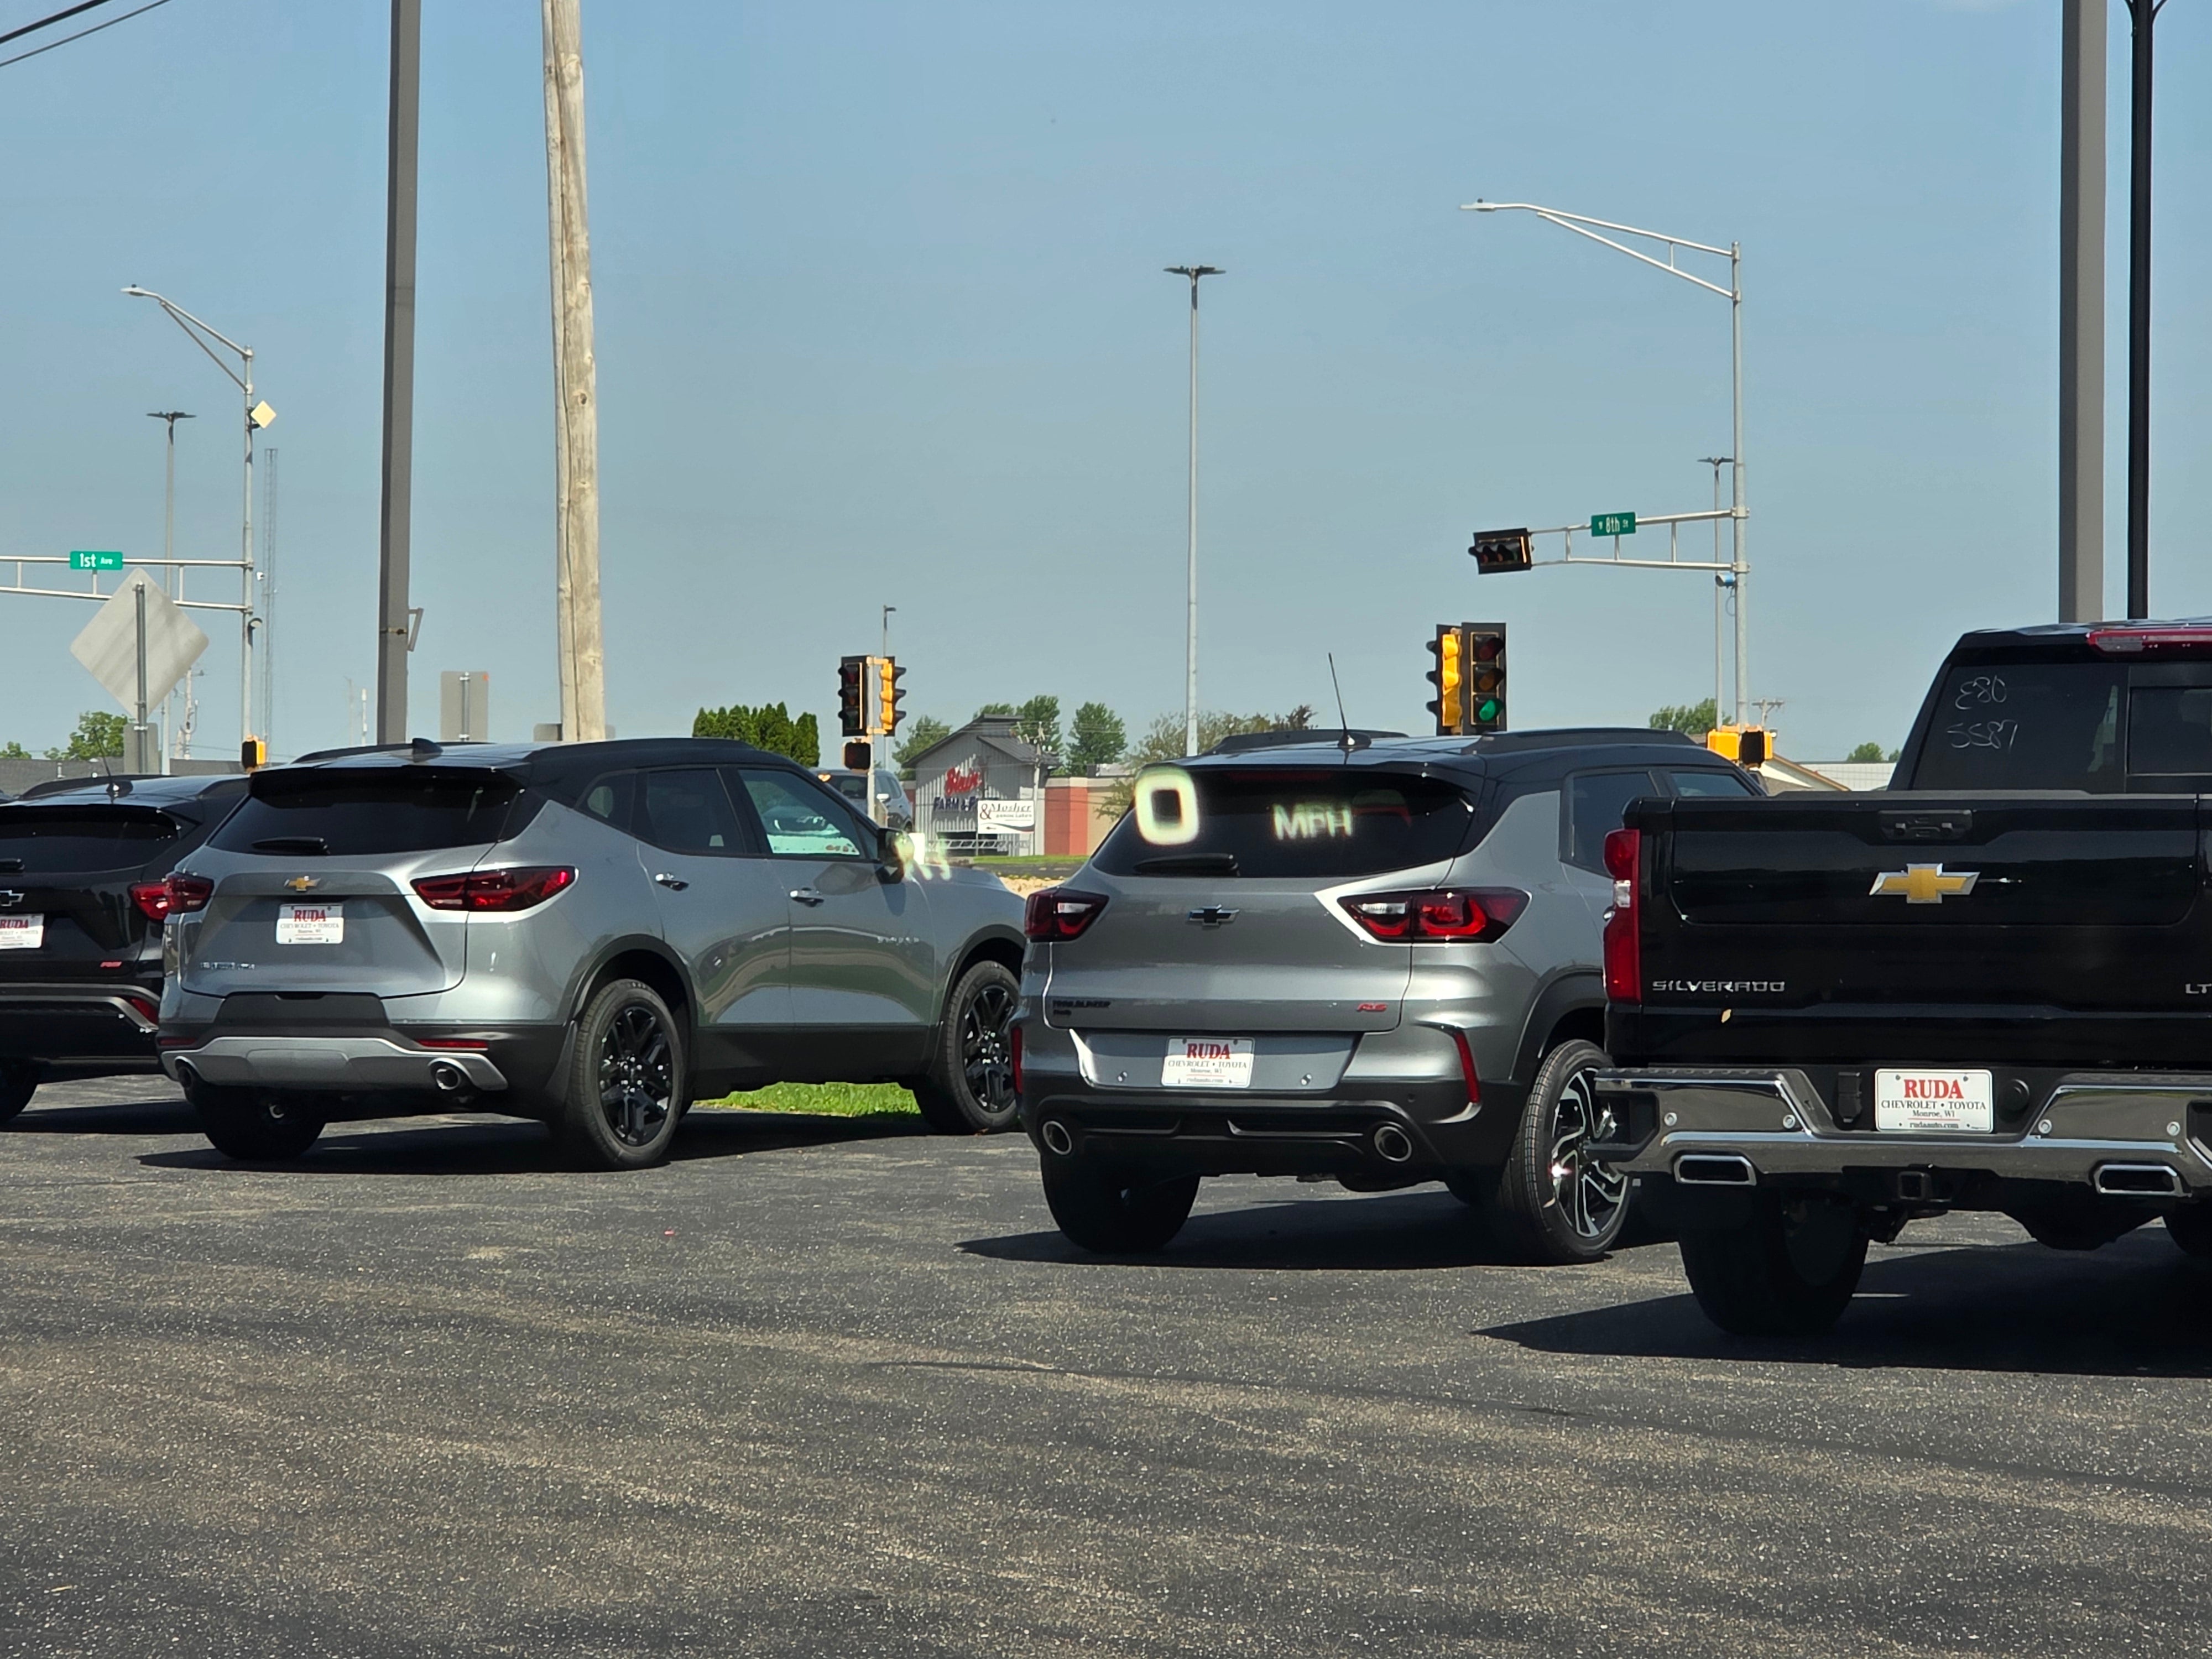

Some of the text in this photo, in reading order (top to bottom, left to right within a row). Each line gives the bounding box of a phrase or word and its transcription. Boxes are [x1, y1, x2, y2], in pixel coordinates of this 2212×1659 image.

[1606, 516, 1620, 534] 8th
[80, 552, 113, 568] 1st Ave
[933, 796, 959, 811] FARM
[979, 803, 992, 820] &
[989, 802, 1032, 813] Mosher
[1272, 802, 1354, 841] MPH
[294, 909, 326, 922] RUDA
[0, 919, 29, 929] RUDA
[1652, 980, 1785, 993] SILVERADO
[1186, 1043, 1230, 1059] RUDA
[1903, 1079, 1964, 1099] RUDA
[1881, 1099, 1986, 1110] CHEVROLET TOYOTA
[1912, 1109, 1943, 1119] Monroe,
